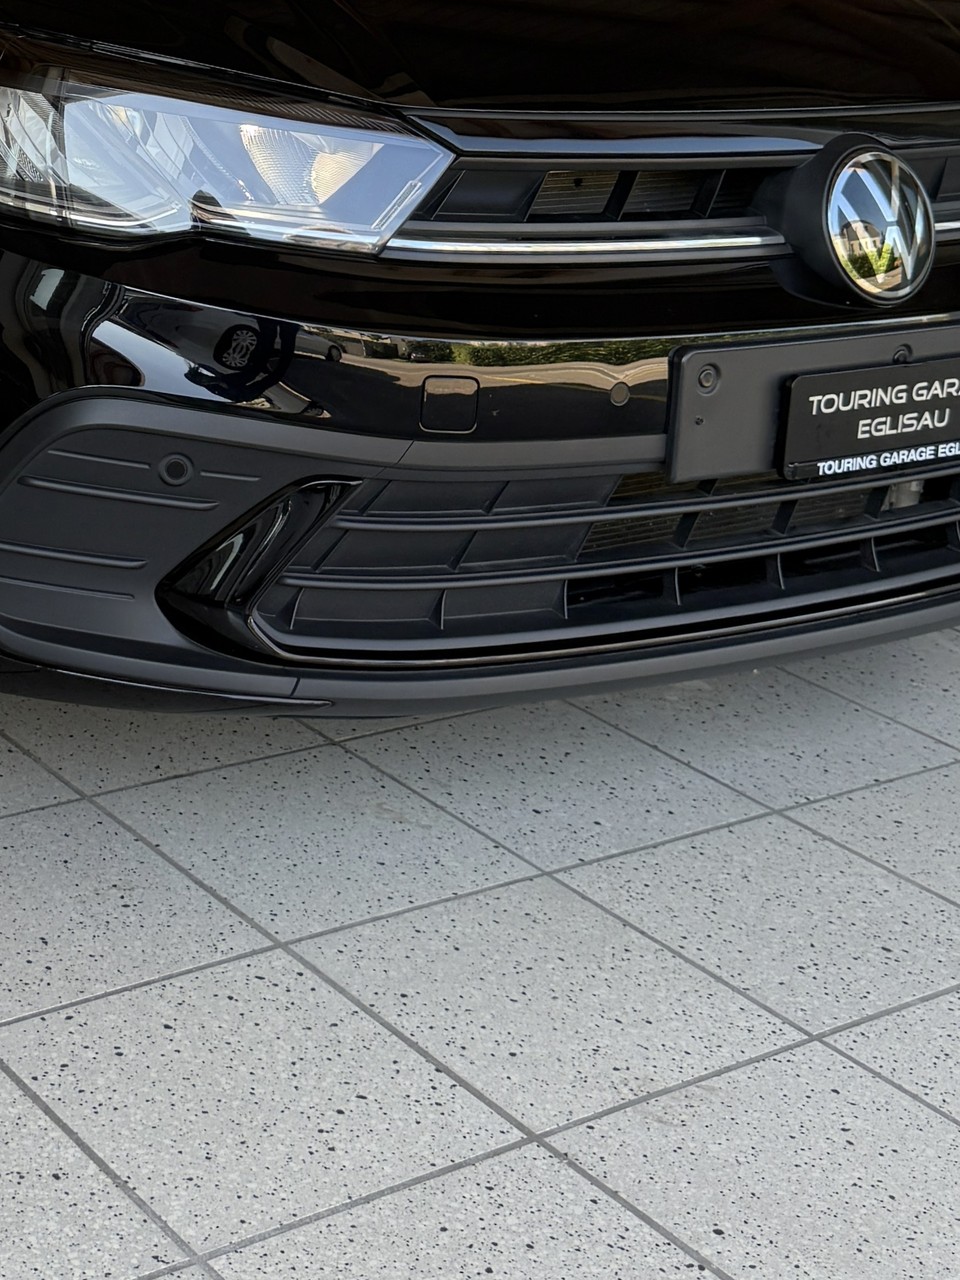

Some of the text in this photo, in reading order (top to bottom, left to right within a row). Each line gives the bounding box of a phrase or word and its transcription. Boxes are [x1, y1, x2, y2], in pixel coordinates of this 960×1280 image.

[809, 378, 960, 415] TOURING GAR
[857, 408, 950, 439] EGLISAU
[817, 454, 877, 476] TOURING
[880, 446, 937, 467] GARAGE
